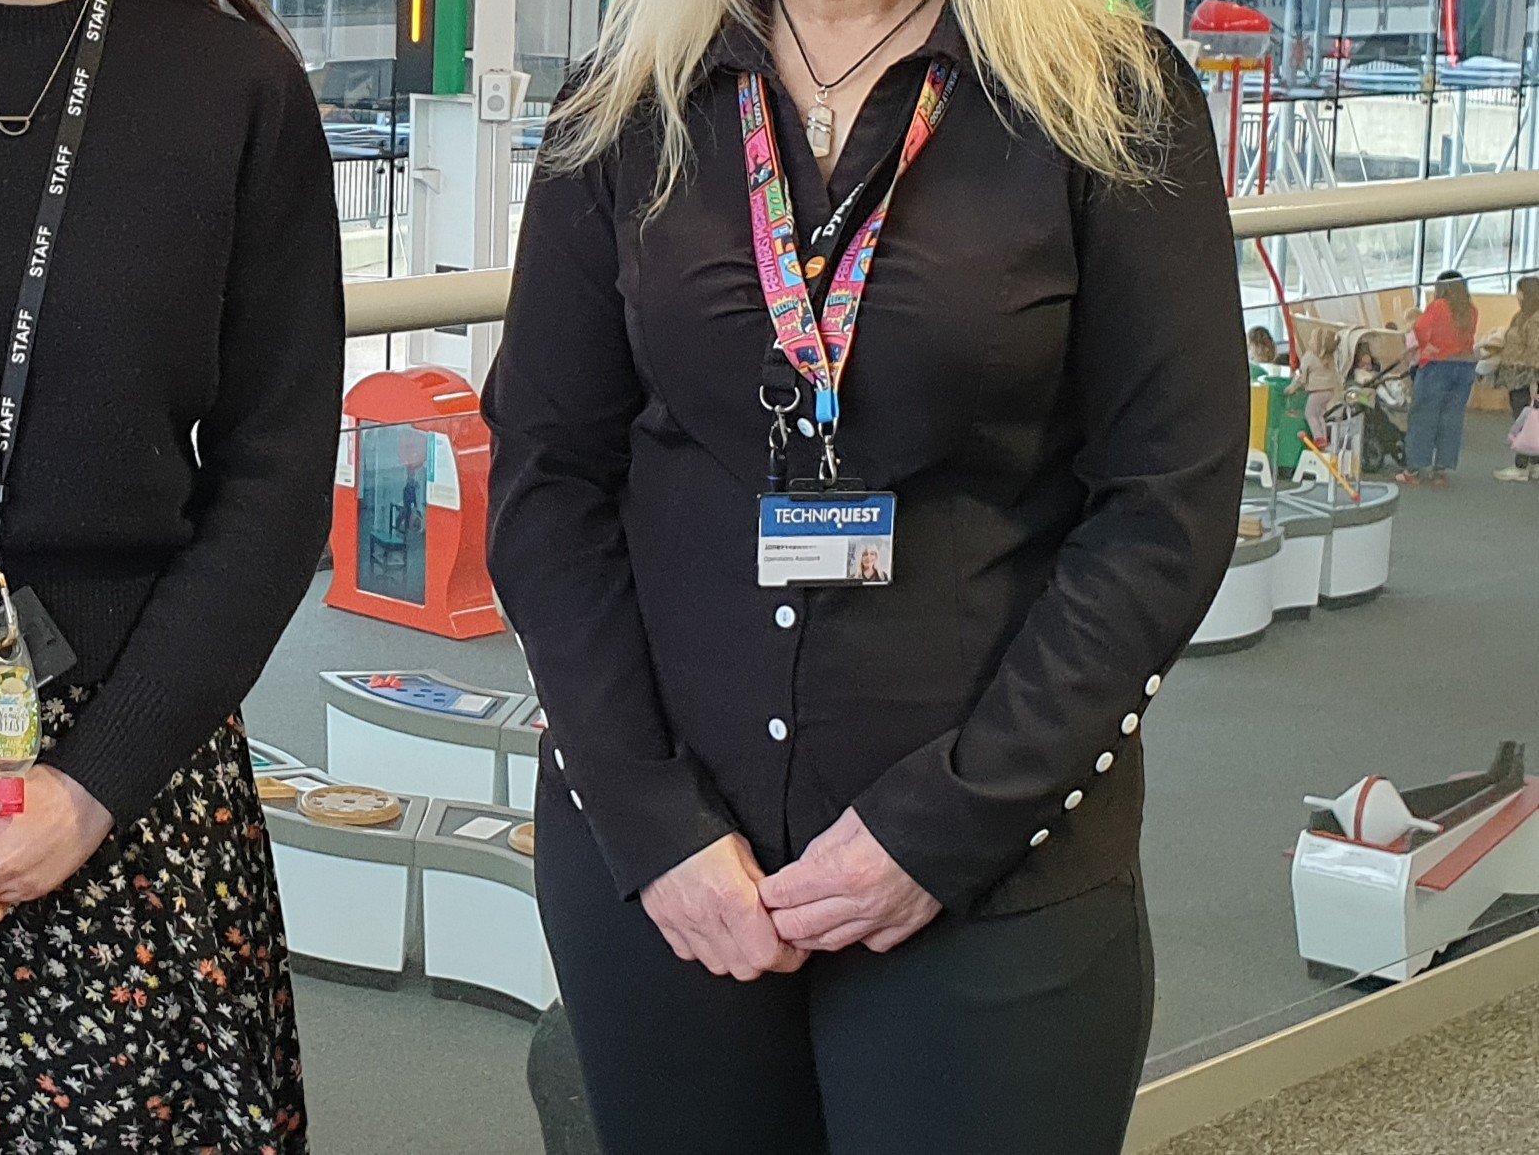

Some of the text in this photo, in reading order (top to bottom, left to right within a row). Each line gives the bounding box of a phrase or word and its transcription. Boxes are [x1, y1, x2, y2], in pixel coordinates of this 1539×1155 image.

[11, 309, 33, 364] STAFF
[29, 225, 53, 278] STAFF
[48, 144, 73, 195] STAFF
[67, 67, 90, 116] STAFF
[774, 507, 881, 529] TECHNIQUEST
